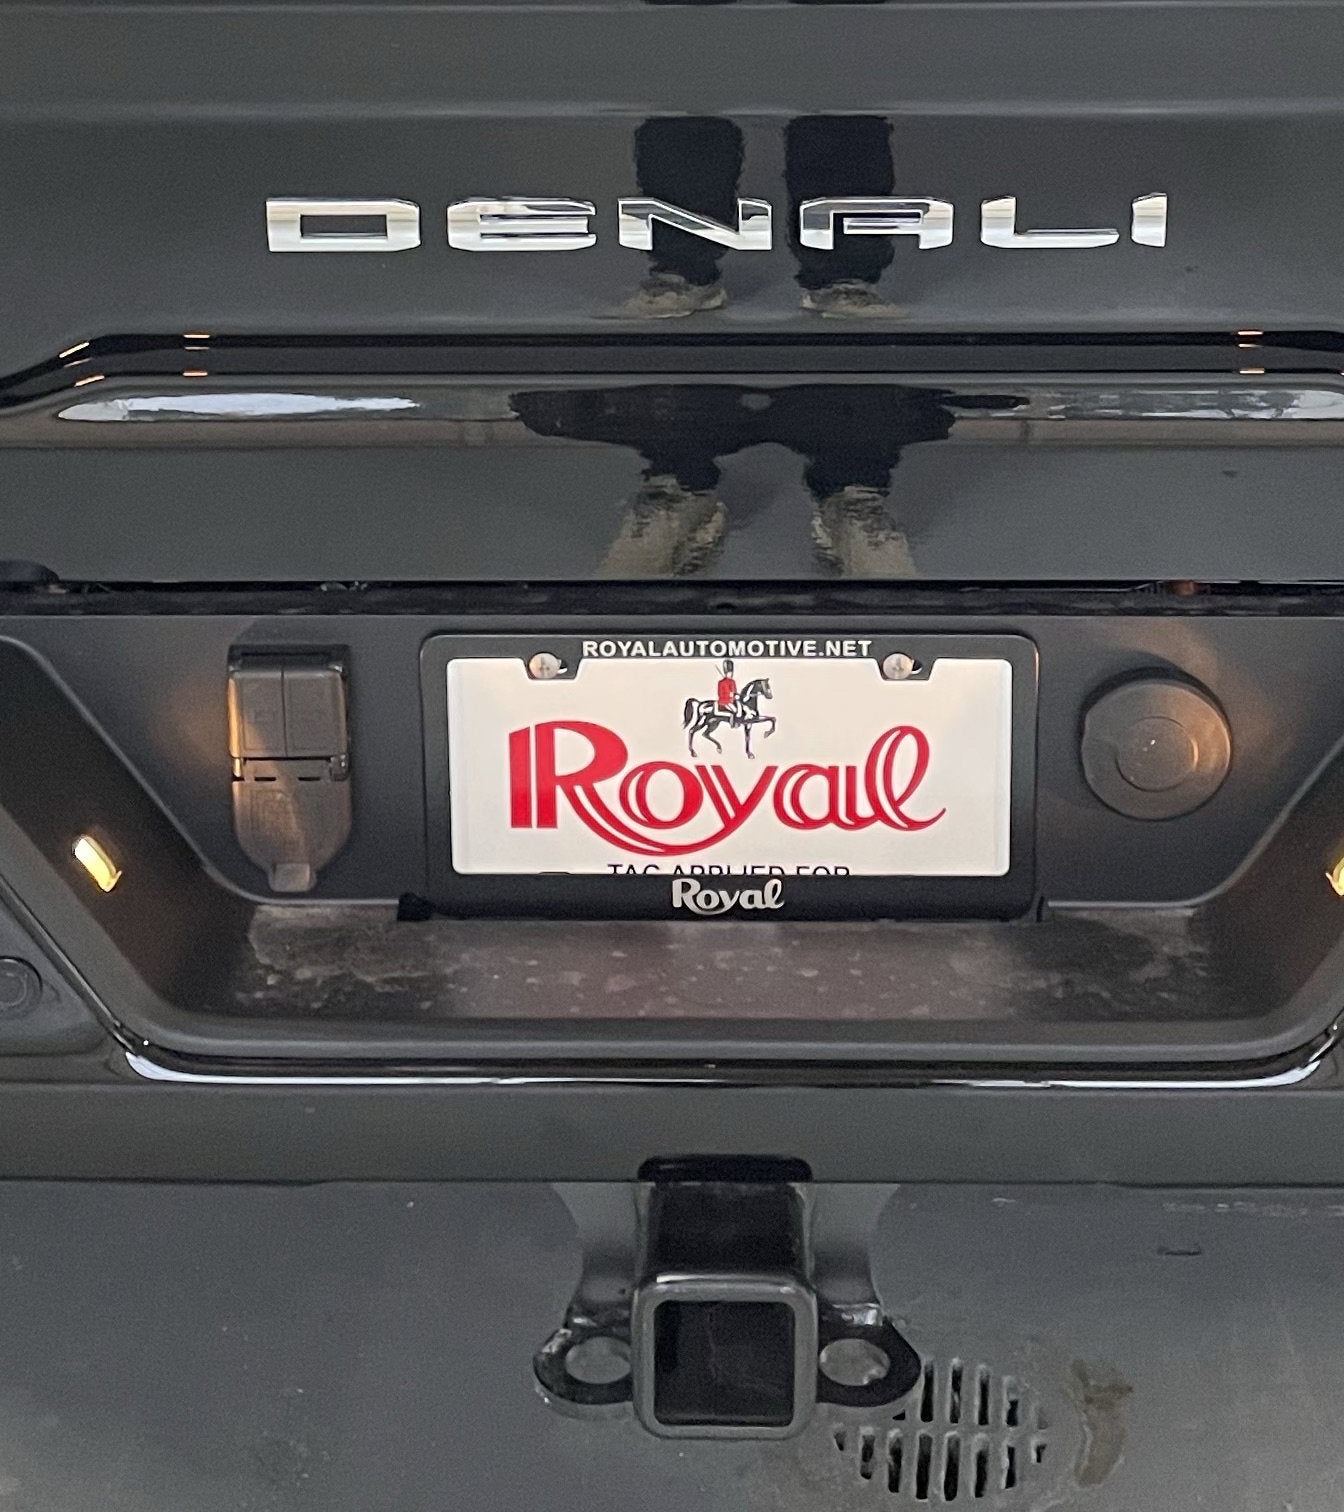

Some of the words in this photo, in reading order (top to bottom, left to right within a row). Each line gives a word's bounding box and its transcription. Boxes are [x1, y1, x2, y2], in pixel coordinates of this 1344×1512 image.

[265, 193, 1168, 253] DENALI
[582, 640, 873, 657] ROYALAUTOMOTIVE.NET
[508, 720, 947, 856] Royal
[672, 878, 785, 916] Royal
